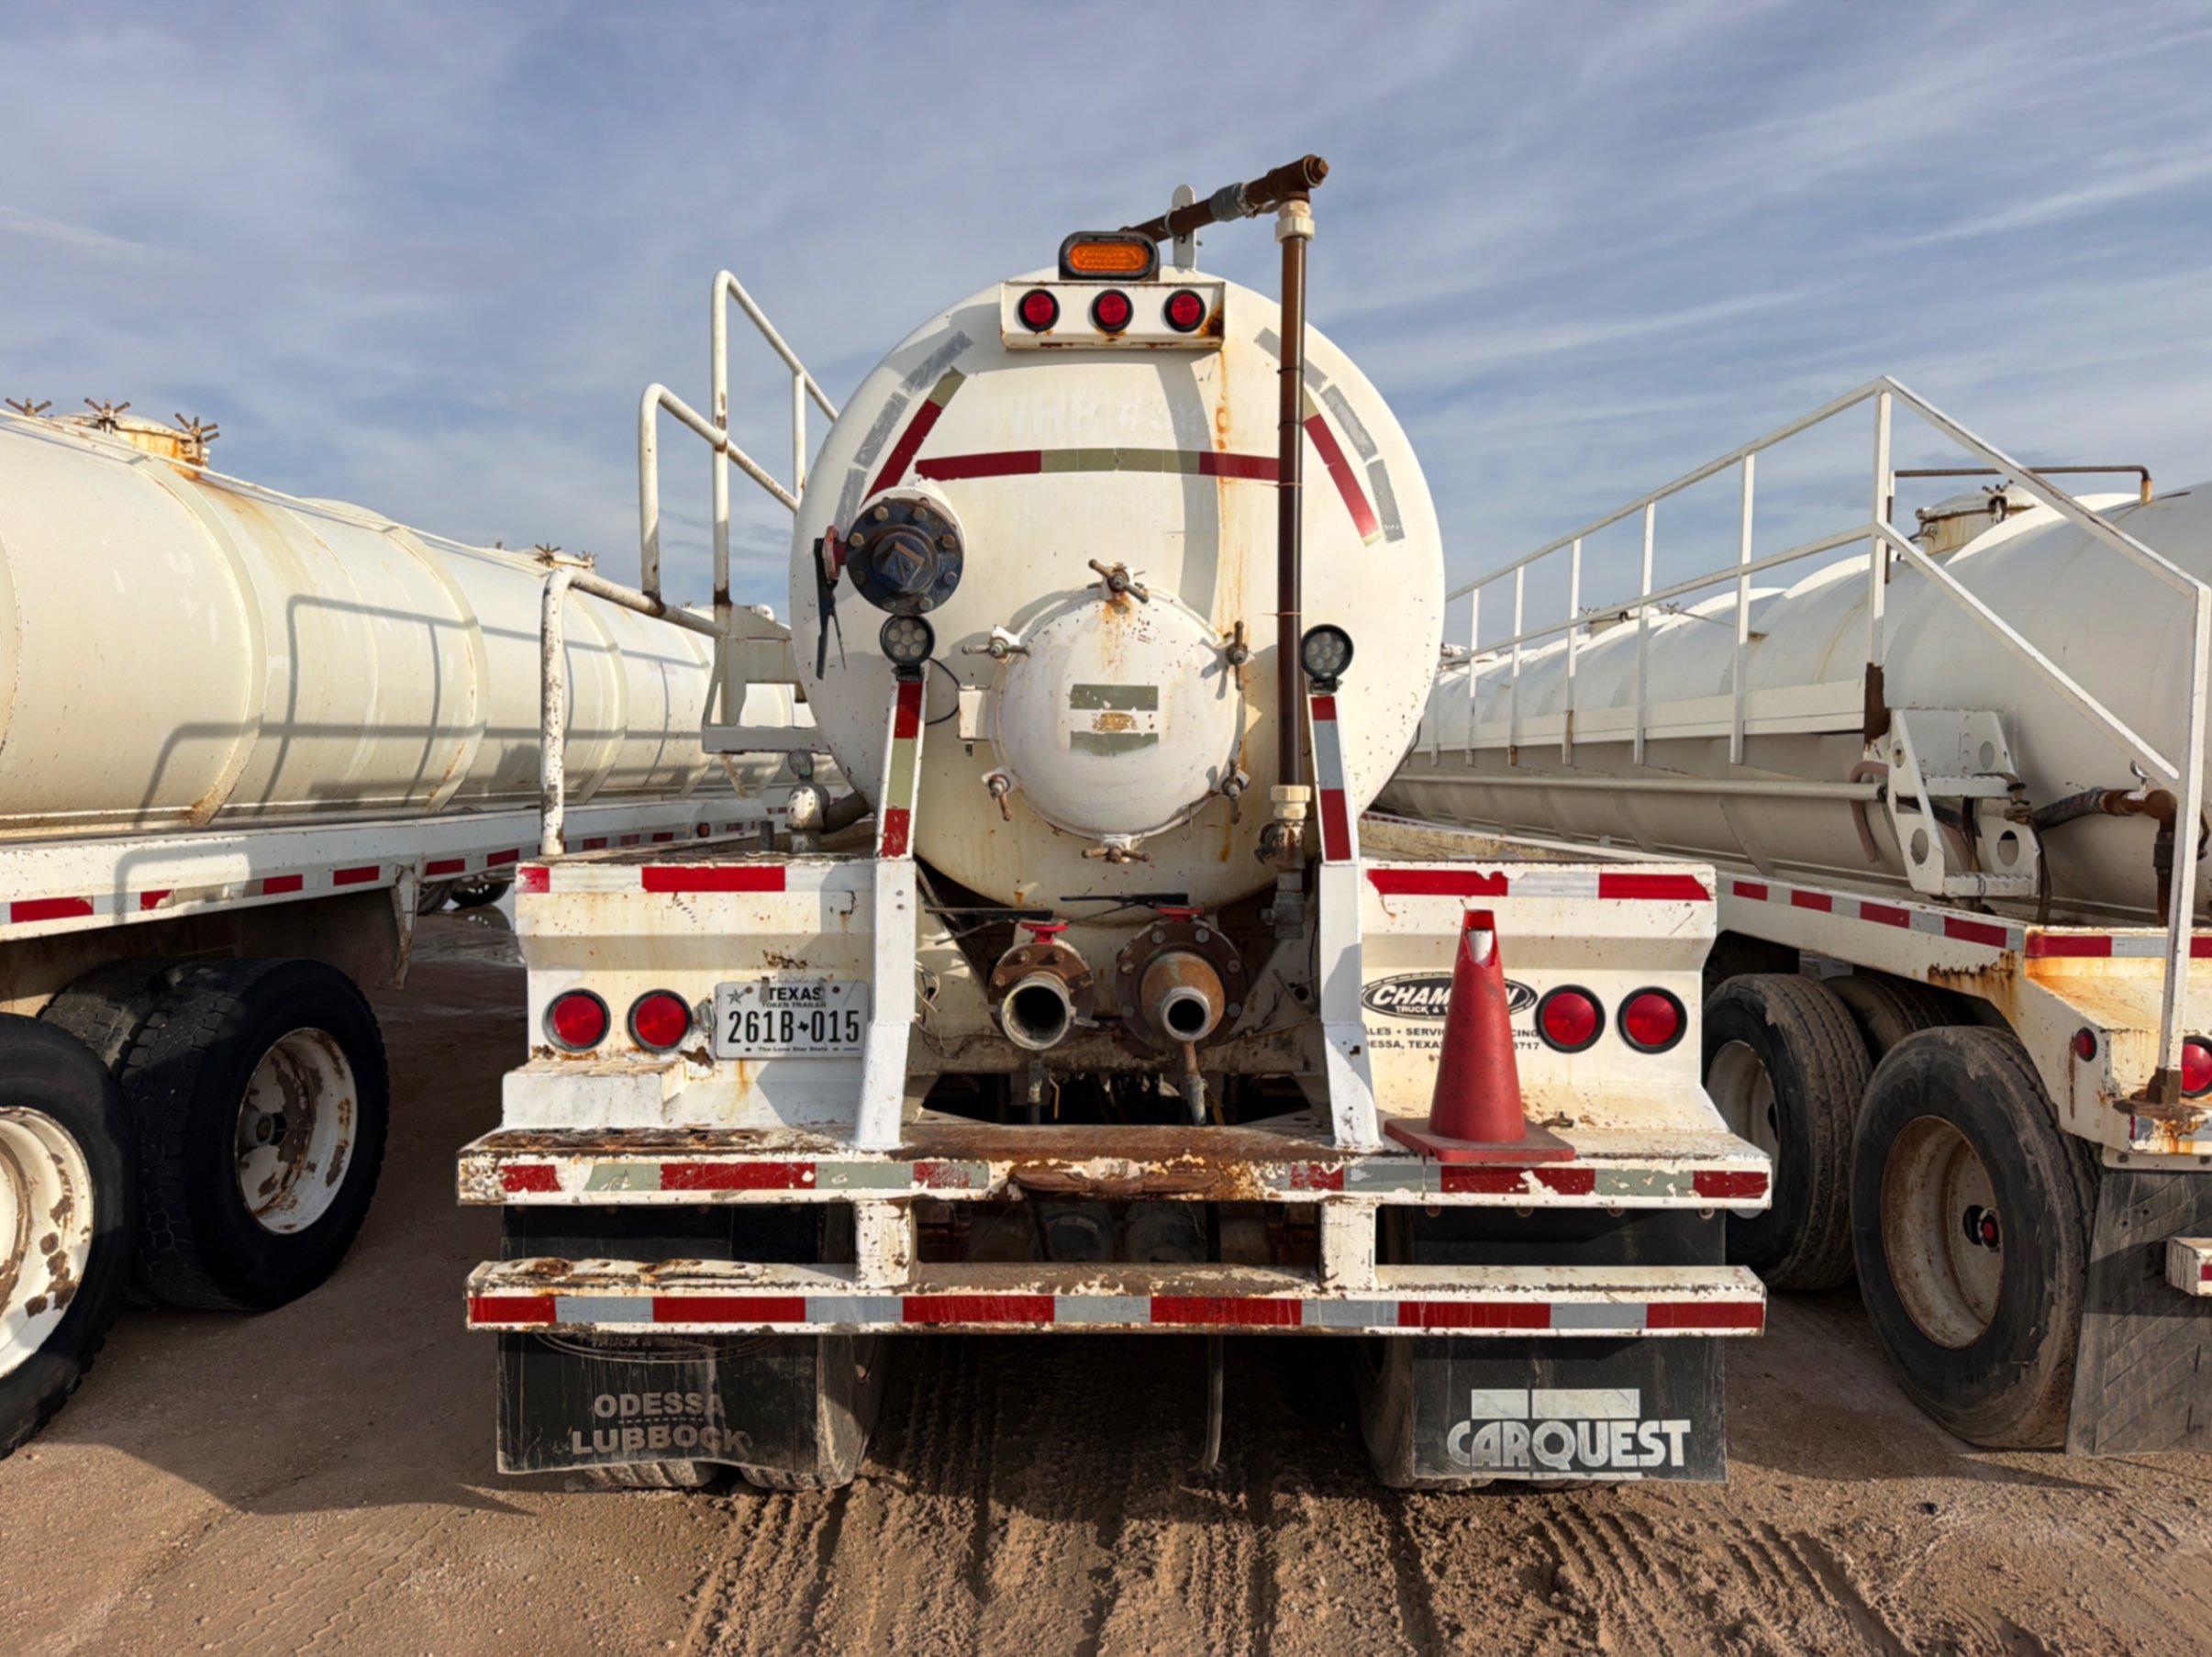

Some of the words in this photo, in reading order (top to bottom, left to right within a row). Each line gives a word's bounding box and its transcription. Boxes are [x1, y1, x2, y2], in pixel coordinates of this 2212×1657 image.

[768, 986, 822, 1001] TEXAS
[1372, 984, 1520, 1006] CHAMN
[1395, 1005, 1429, 1015] TRUCK
[728, 1010, 794, 1043] 261B
[810, 1010, 861, 1043] 015
[1365, 1027, 1392, 1037] LES
[1406, 1027, 1445, 1037] SERVI
[1367, 1040, 1406, 1051] ESSA,
[1407, 1040, 1443, 1050] TEXA
[594, 1392, 726, 1418] ODESSA
[572, 1424, 749, 1456] LUBBOCK
[1446, 1418, 1692, 1471] CARQUEST
